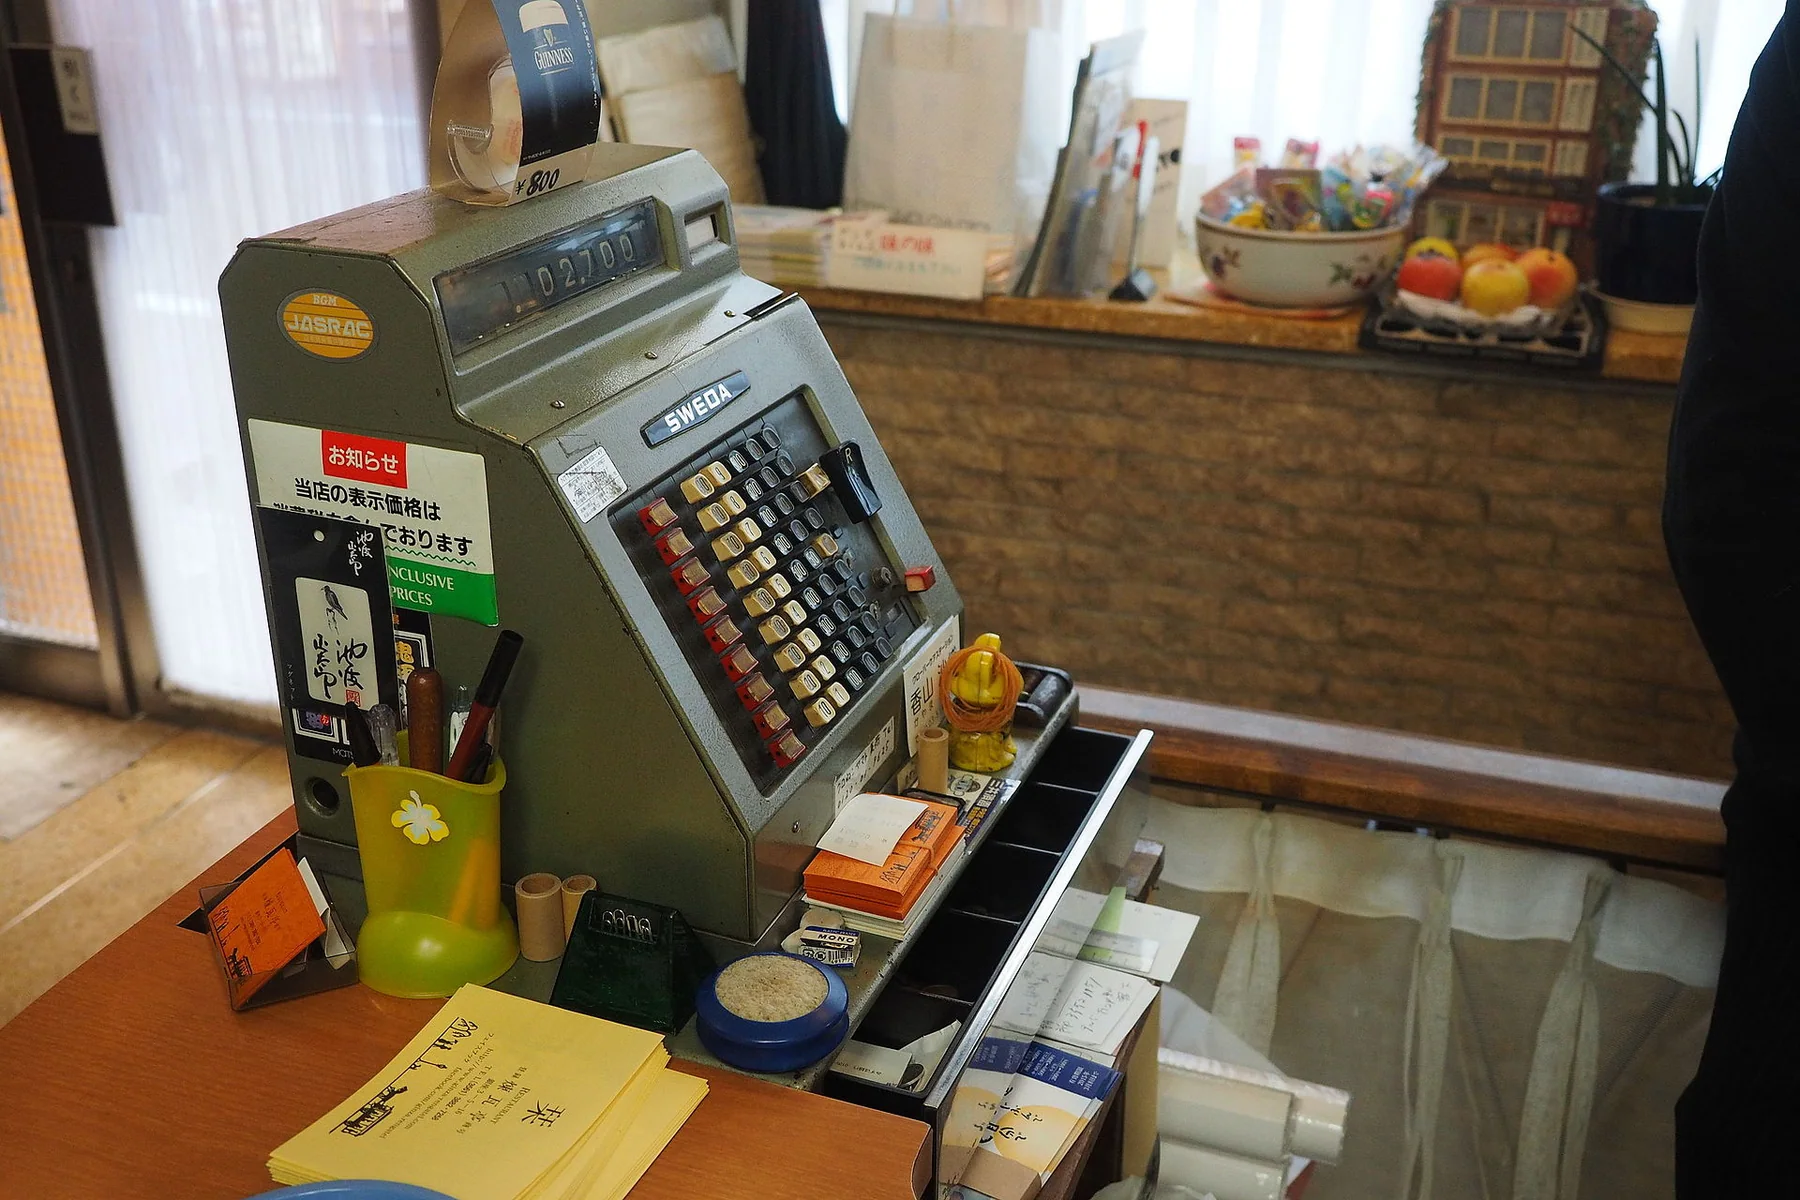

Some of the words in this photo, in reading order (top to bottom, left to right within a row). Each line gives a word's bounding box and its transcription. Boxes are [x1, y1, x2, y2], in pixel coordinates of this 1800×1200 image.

[534, 47, 574, 70] GUINNESS
[313, 294, 338, 306] BGM
[288, 314, 370, 338] JASRAC
[664, 383, 733, 433] SWEDA
[329, 445, 399, 475] お知らせ
[845, 447, 853, 464] R
[295, 476, 442, 521] 当店の表示価格は
[388, 565, 455, 591] NCLUSIVE
[390, 586, 433, 606] PRICES
[818, 934, 854, 943] MONO
[521, 1099, 566, 1128] 栞
